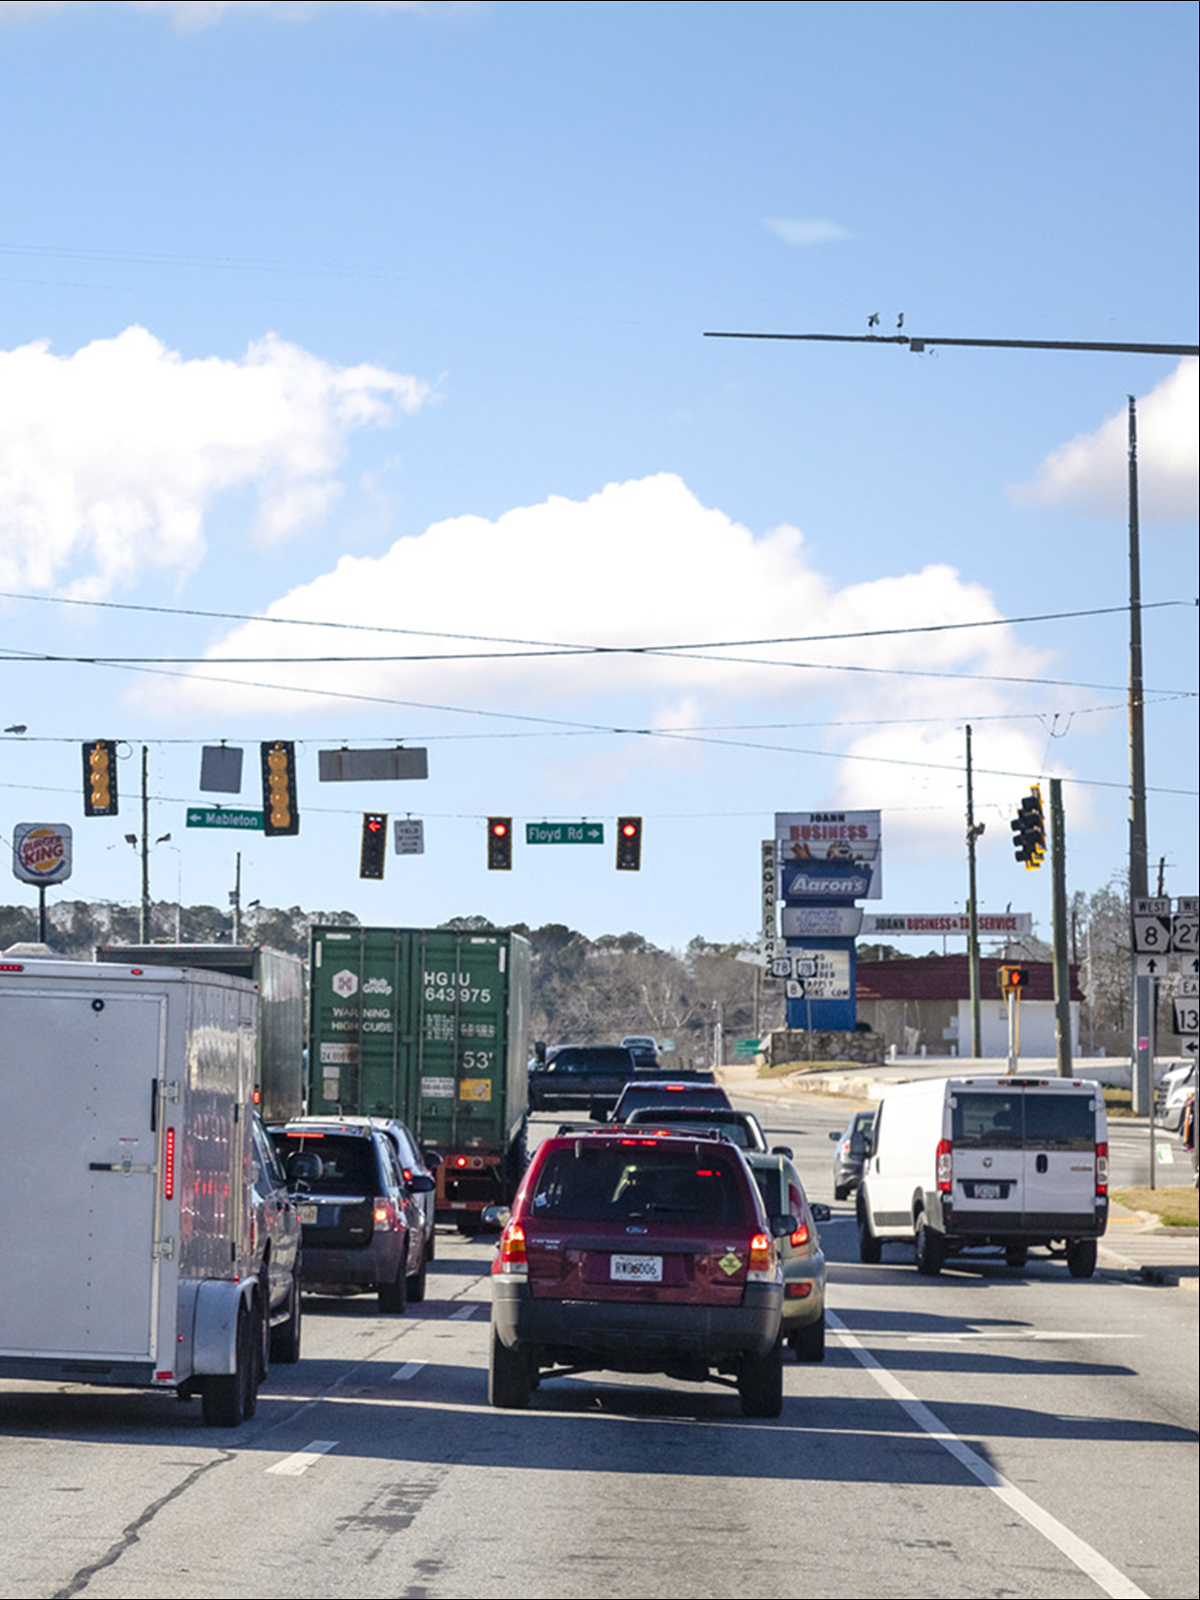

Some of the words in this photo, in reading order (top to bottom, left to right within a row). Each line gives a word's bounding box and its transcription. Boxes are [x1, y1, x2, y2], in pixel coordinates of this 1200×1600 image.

[205, 812, 258, 826] Mableton
[810, 814, 845, 822] JOANN
[528, 828, 562, 842] Floyd
[567, 828, 584, 841] Rd
[789, 825, 868, 840] BUSINESS
[23, 835, 62, 853] BURGER
[25, 844, 64, 867] KING
[763, 846, 775, 907] RAGAN
[793, 876, 863, 892] Aaron's
[1138, 902, 1166, 912] WEST
[875, 918, 906, 930] JOANN
[907, 918, 951, 930] BUSINESS
[978, 918, 1017, 930] SERVICE
[1144, 926, 1158, 946] 8
[776, 961, 789, 973] 78
[368, 977, 388, 987] Hub
[424, 972, 470, 987] HGIU
[362, 984, 393, 996] Group
[424, 987, 491, 1004] 643975
[790, 983, 798, 996] 8
[331, 1021, 359, 1031] HIGH
[362, 1022, 394, 1033] CUBE
